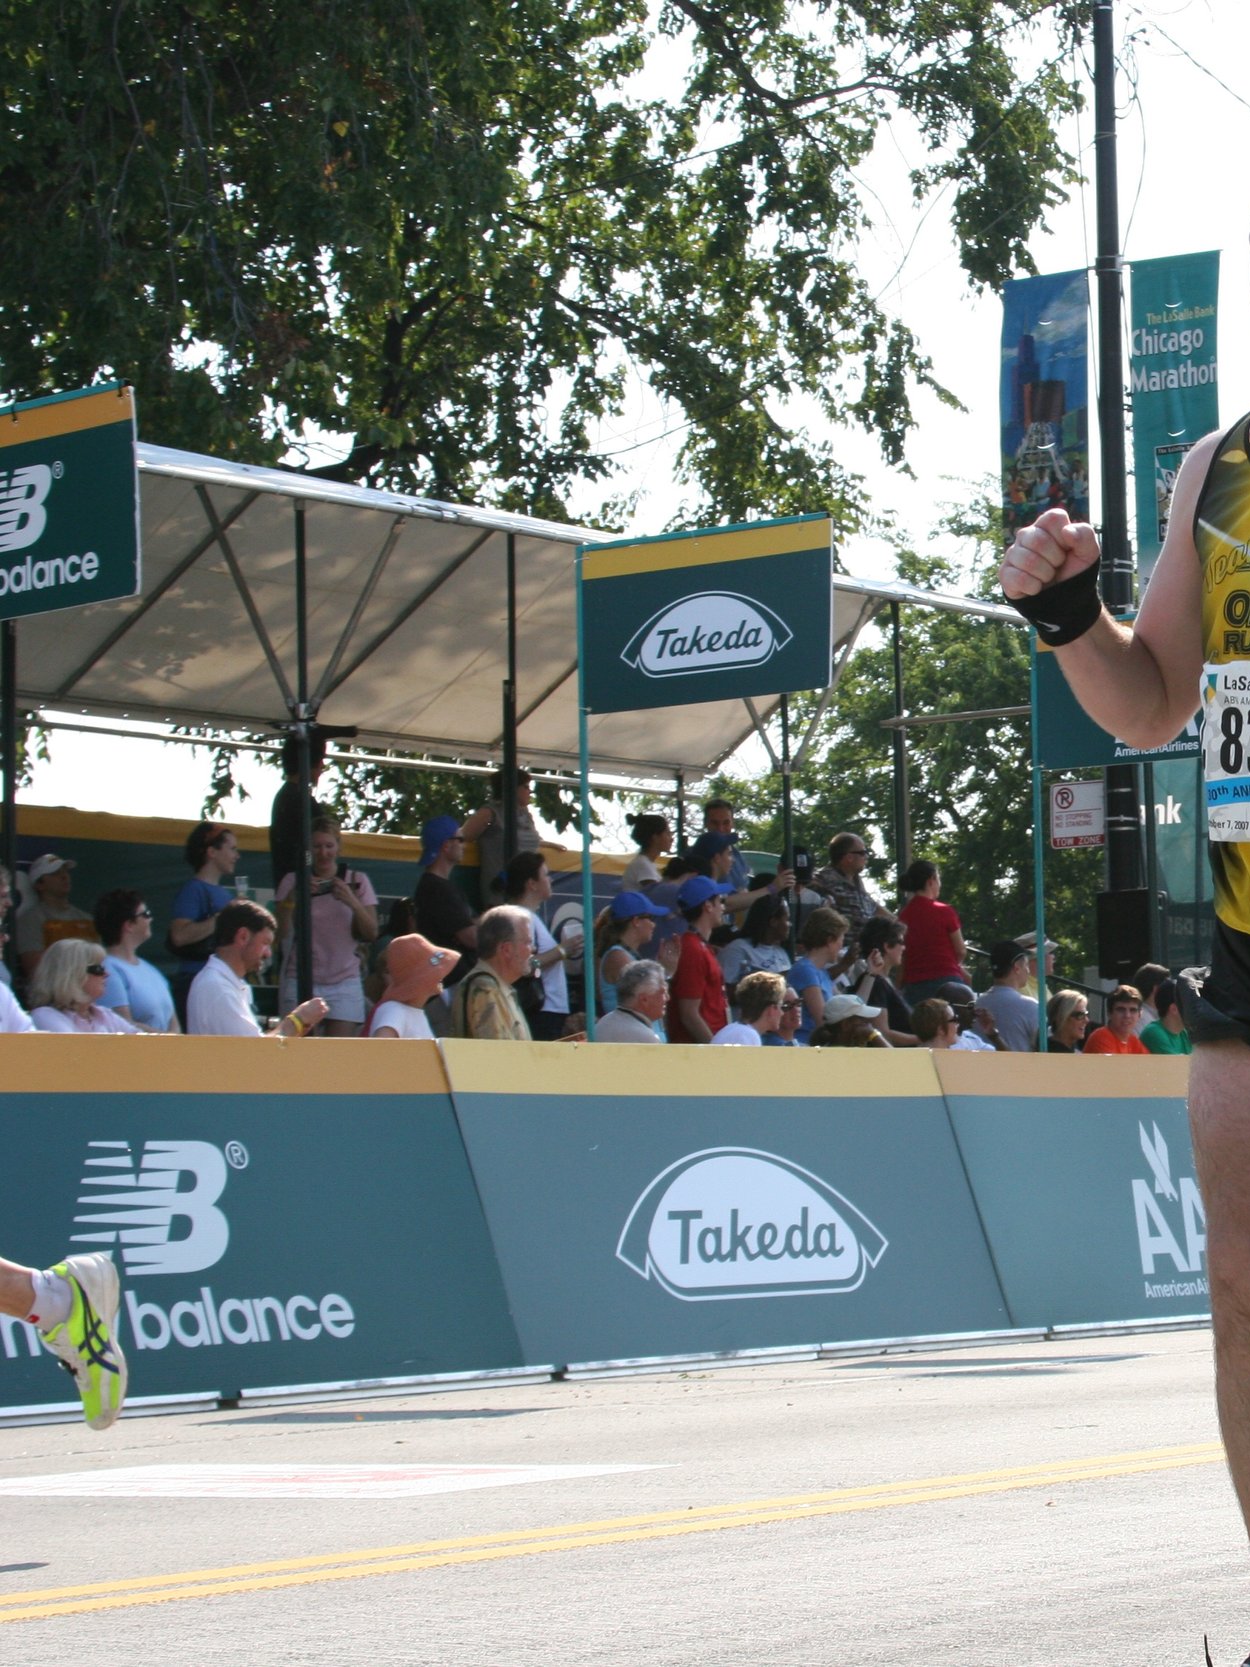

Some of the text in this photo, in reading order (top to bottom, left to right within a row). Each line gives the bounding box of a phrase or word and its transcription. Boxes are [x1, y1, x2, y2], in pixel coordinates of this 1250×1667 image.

[1146, 304, 1216, 325] The LaSalle Bank
[1131, 328, 1204, 356] Chicago
[1131, 359, 1218, 393] Marathon
[656, 619, 763, 659] Takeda
[1056, 835, 1101, 846] TOW ZONE
[1227, 820, 1234, 830] 7,
[1234, 820, 1249, 830] 2007
[667, 1206, 844, 1265] Takeda
[124, 1286, 356, 1351] balance
